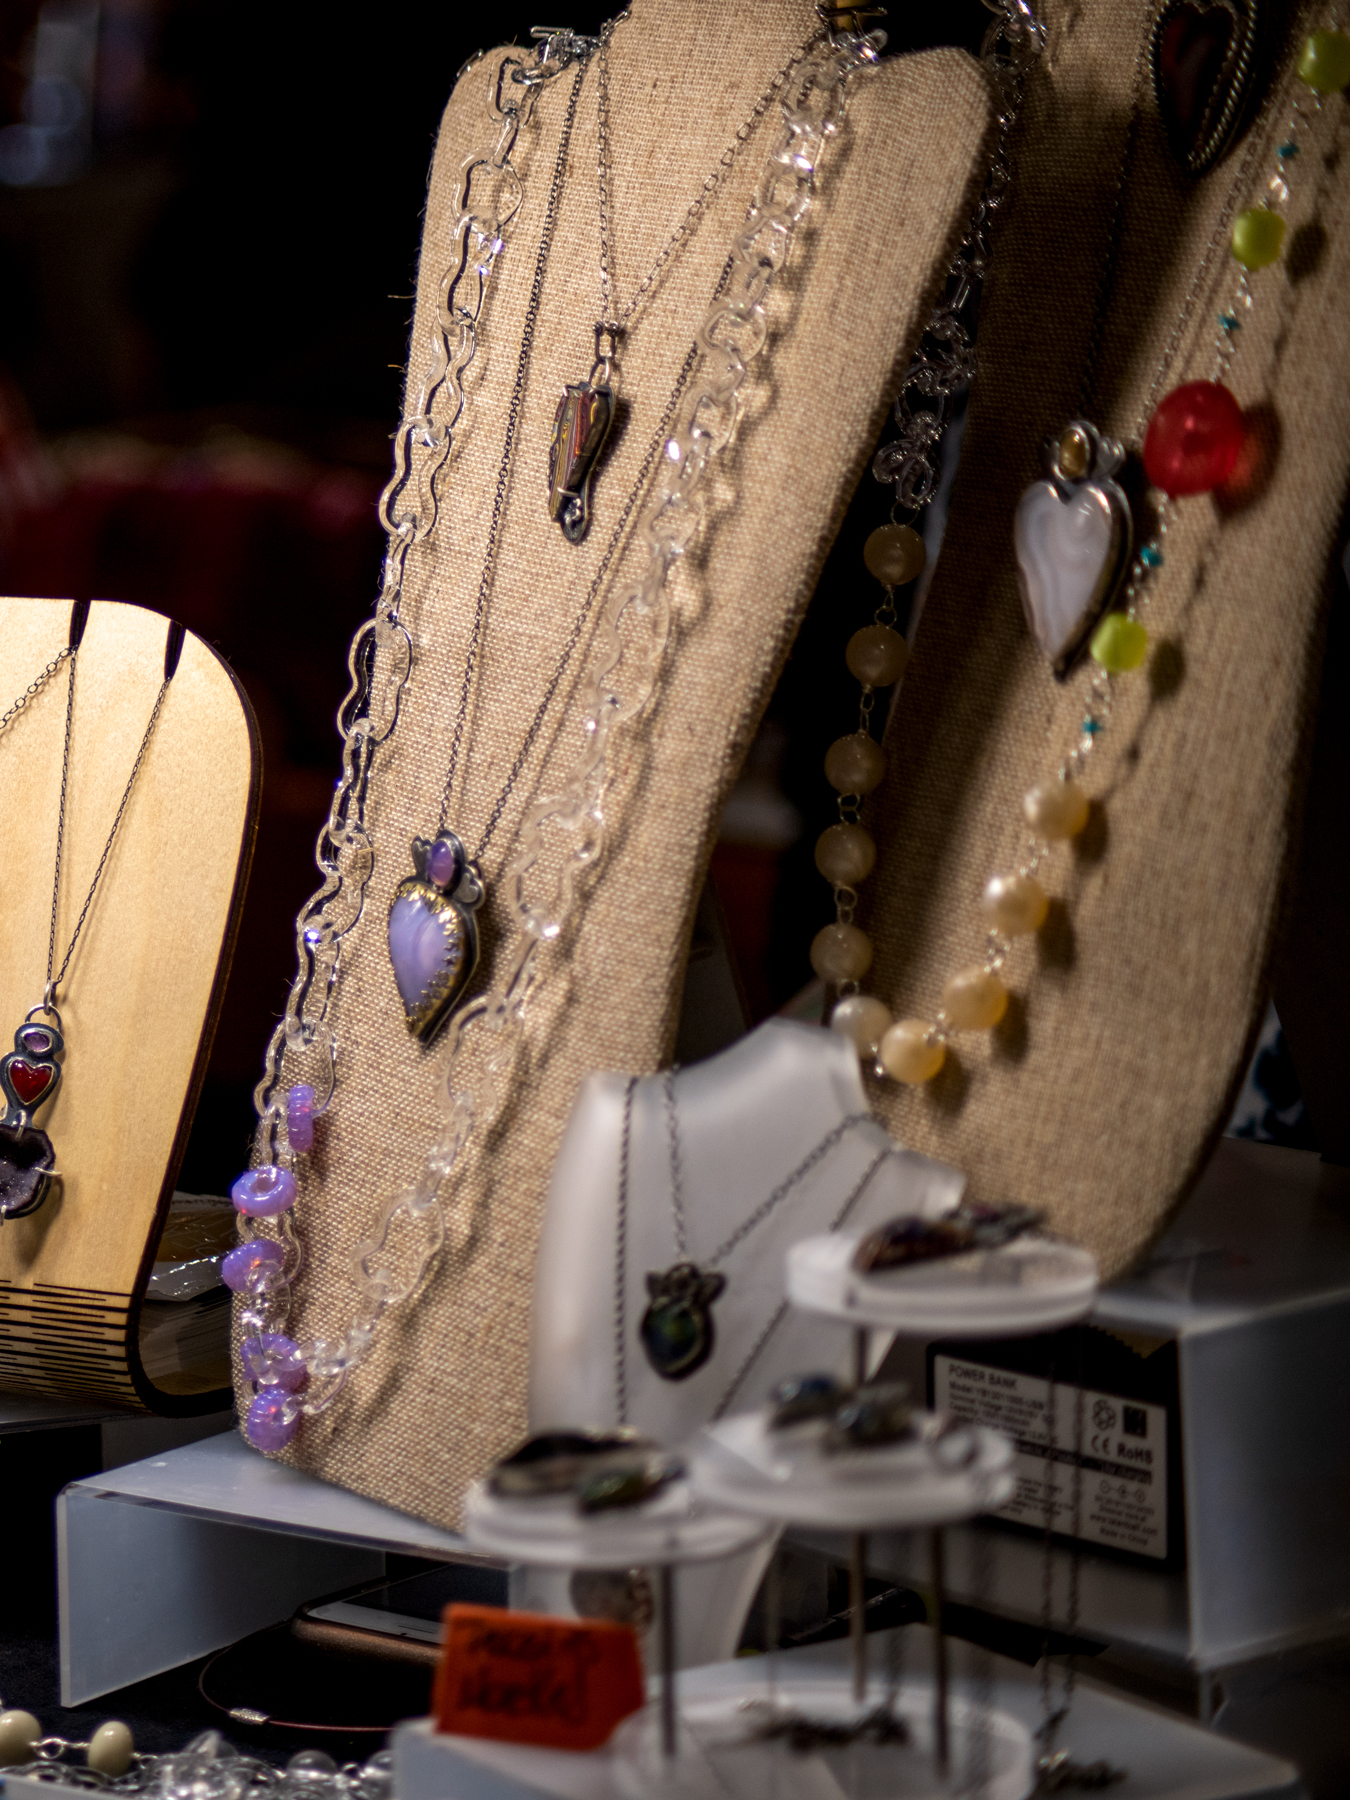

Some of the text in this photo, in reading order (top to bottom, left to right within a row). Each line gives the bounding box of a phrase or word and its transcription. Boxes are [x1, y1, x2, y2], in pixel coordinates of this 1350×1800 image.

[949, 1364, 1016, 1389] POWER BANK
[1116, 1442, 1153, 1465] RoHS
